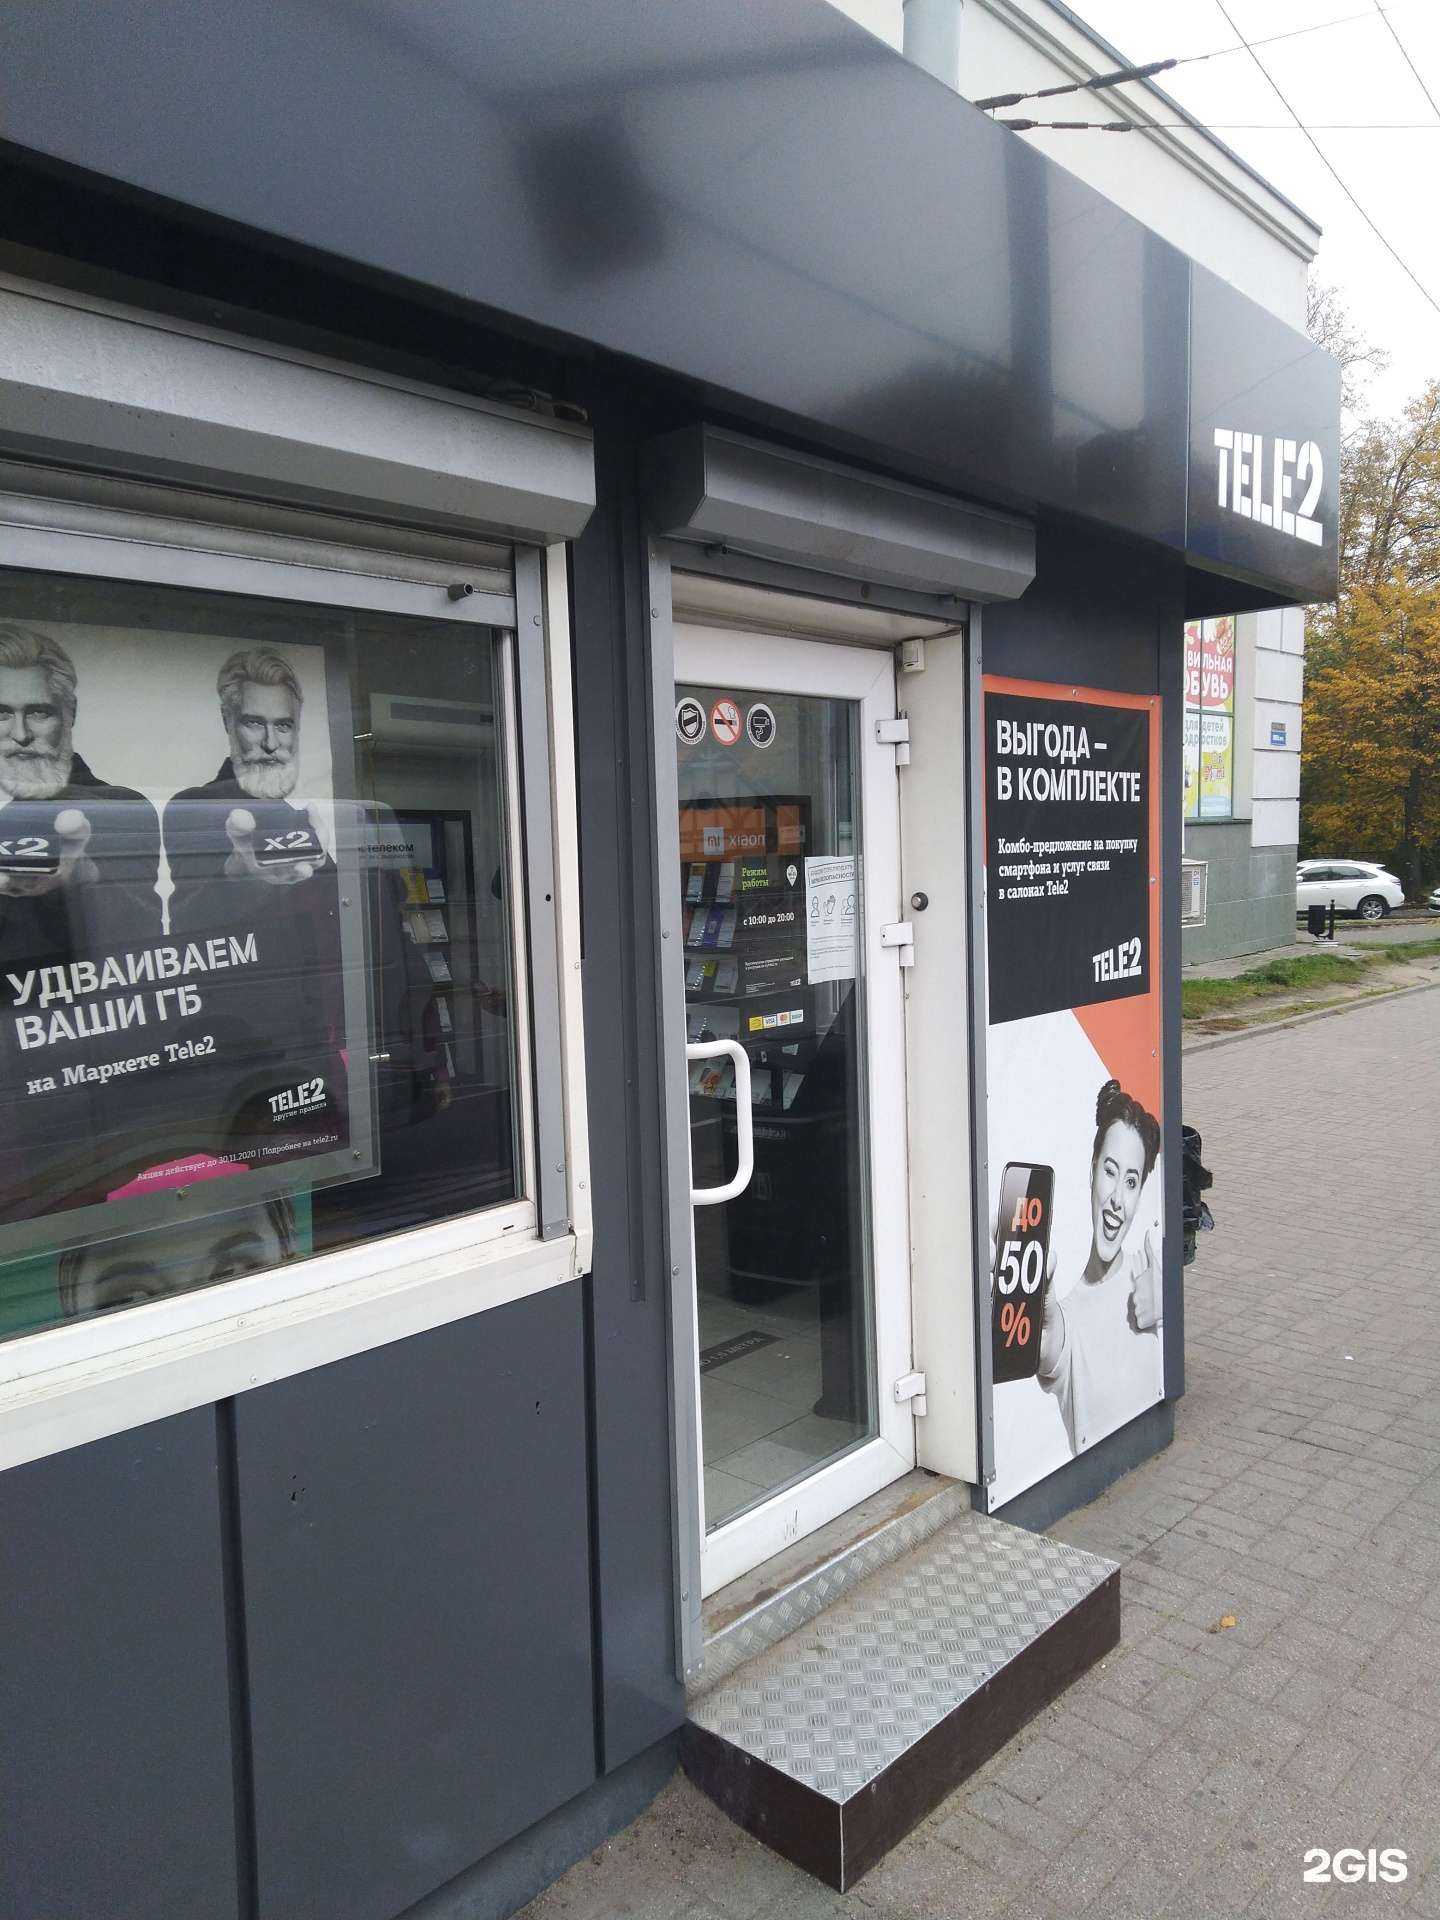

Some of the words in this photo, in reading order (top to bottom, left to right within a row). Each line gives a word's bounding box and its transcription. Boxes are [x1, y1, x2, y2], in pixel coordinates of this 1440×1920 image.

[1214, 428, 1323, 546] TELE2
[1184, 650, 1233, 673] ВИЛЬНАЯ
[996, 719, 1091, 765] ВЫГОДА
[997, 766, 1013, 801] В
[1018, 767, 1141, 802] КОМПЛЕКТЕ
[998, 837, 1092, 857] Комбо-предложение
[1093, 839, 1104, 850] на
[1105, 838, 1139, 854] покупку
[741, 867, 768, 878] Режим
[741, 878, 769, 892] работы
[999, 860, 1051, 880] смартфона
[1052, 863, 1060, 873] и
[1061, 862, 1086, 877] услуг
[1087, 860, 1110, 871] связи
[999, 888, 1005, 900] в
[1007, 885, 1045, 899] салонах
[1046, 879, 1069, 896] Tele2
[748, 914, 767, 926] 10:00
[767, 915, 776, 925] до
[776, 911, 795, 922] 20:00
[6, 933, 258, 1009] УДВАИВАЕМ
[1092, 937, 1142, 983] TELE2
[15, 995, 147, 1050] ВАШИ
[155, 984, 203, 1021] ГБ
[27, 1075, 57, 1095] на
[61, 1052, 160, 1088] Маркете
[164, 1035, 216, 1063] Tele2
[268, 1077, 327, 1114] TELE2
[165, 1160, 206, 1177] действует
[207, 1158, 217, 1168] до
[218, 1149, 256, 1165] 30.11.2020
[262, 1142, 301, 1157] Подробнее
[302, 1139, 312, 1148] на
[312, 1134, 339, 1146] tele2.ru
[998, 1240, 1044, 1295] 50
[1001, 1301, 1031, 1348] %
